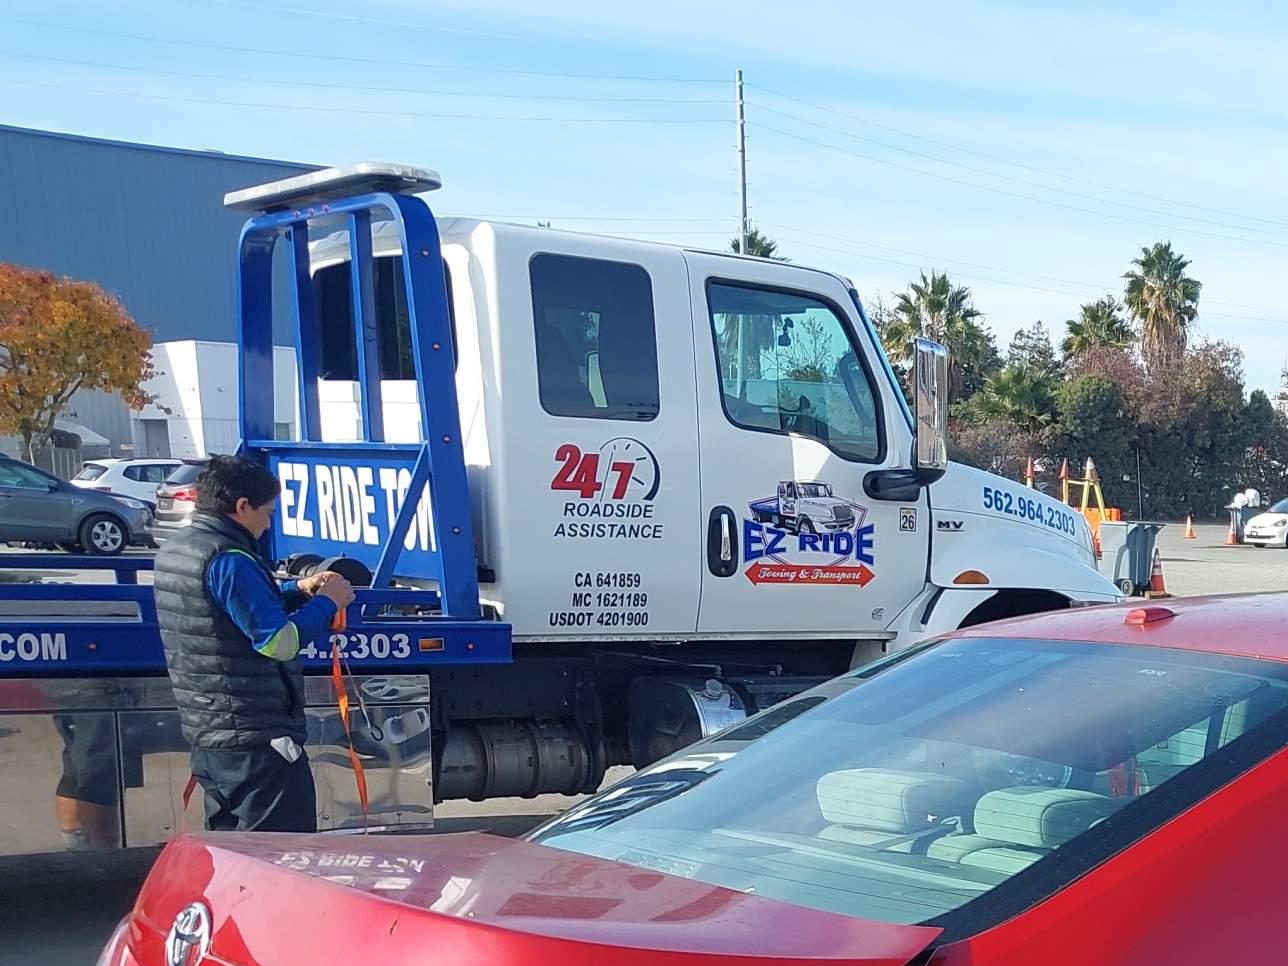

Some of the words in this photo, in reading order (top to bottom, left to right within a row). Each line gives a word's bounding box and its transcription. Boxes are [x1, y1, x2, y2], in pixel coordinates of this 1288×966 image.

[278, 462, 314, 538] EZ
[315, 464, 380, 546] RIDE
[563, 502, 654, 518] ROADSIDE
[983, 486, 1076, 537] 562.964.2303
[901, 514, 915, 530] 26
[937, 520, 964, 529] MV
[554, 523, 663, 539] ASSISTANCE
[743, 517, 787, 564] EZ
[798, 522, 874, 566] RIDE
[574, 572, 593, 588] CA
[596, 573, 641, 588] 641859
[758, 567, 797, 581] Towing
[798, 570, 810, 579] &
[811, 568, 861, 582] Transport
[572, 593, 592, 607] MC
[596, 593, 648, 608] 1621189
[549, 612, 594, 627] USDOT
[596, 612, 649, 627] 4201900
[0, 632, 67, 661] COM
